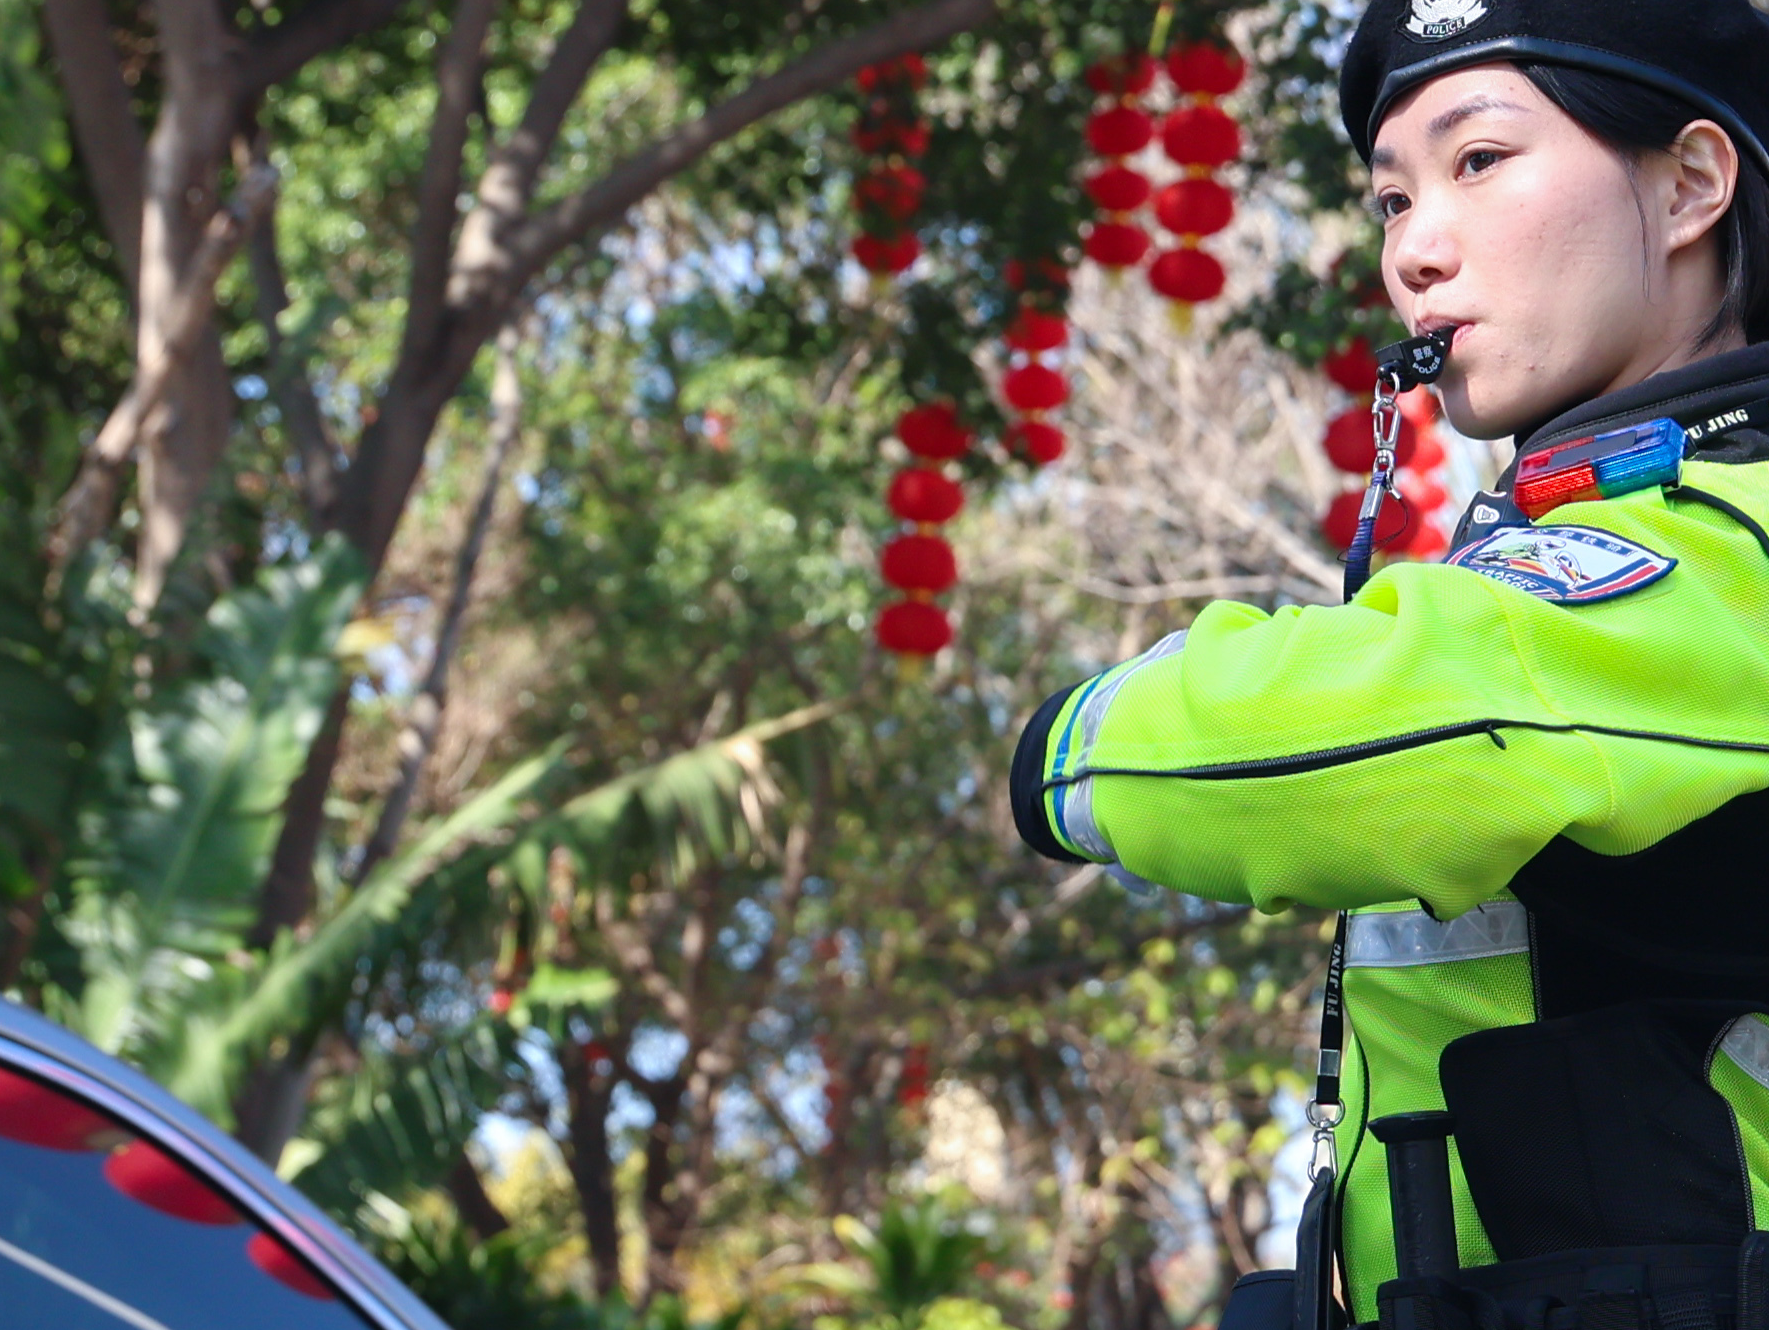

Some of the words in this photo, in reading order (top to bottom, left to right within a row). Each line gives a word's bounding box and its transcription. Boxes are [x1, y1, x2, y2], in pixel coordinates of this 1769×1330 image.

[1426, 19, 1463, 35] POLICE
[1412, 356, 1441, 374] POLICE
[1684, 425, 1703, 439] U
[1707, 409, 1749, 432] JING
[1329, 943, 1342, 989] JING
[1326, 992, 1339, 1018] FU
